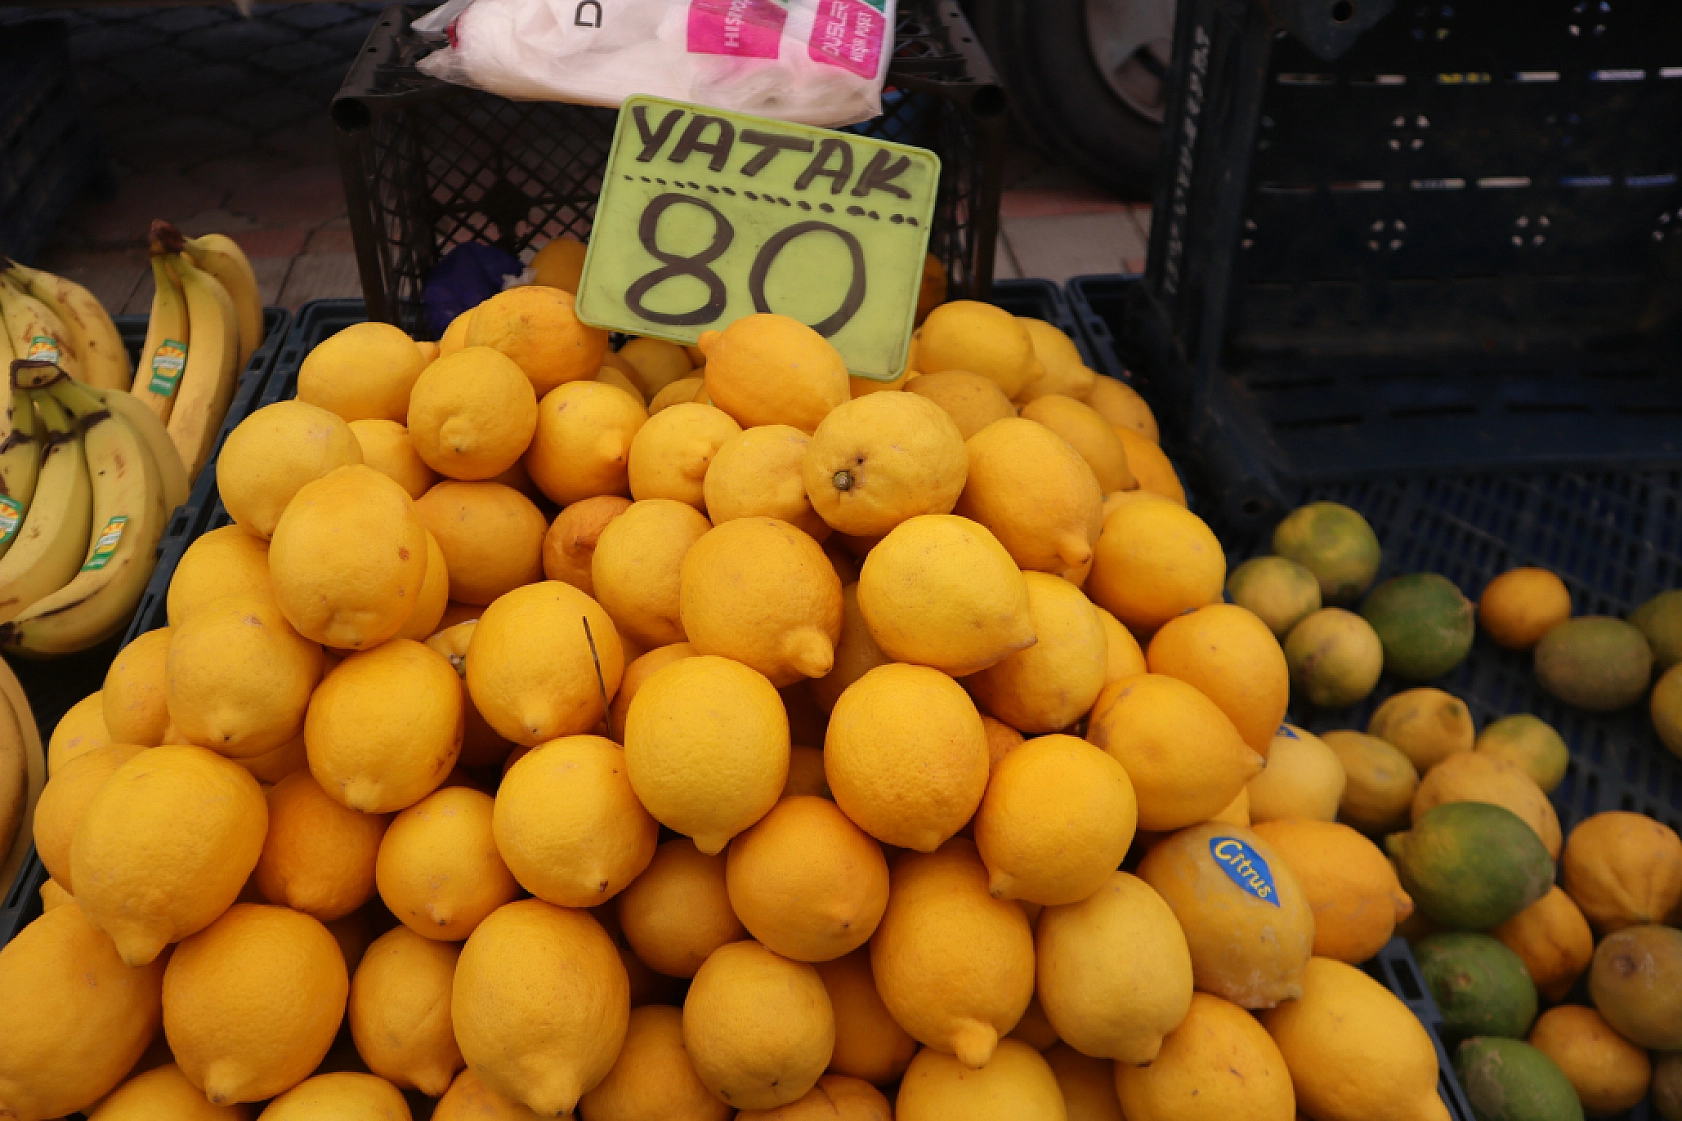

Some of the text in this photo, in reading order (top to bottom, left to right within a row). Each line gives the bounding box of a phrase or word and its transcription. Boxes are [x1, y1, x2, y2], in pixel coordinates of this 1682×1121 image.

[632, 105, 912, 200] YATAK
[624, 193, 867, 339] 80
[1215, 839, 1272, 898] Citrus
